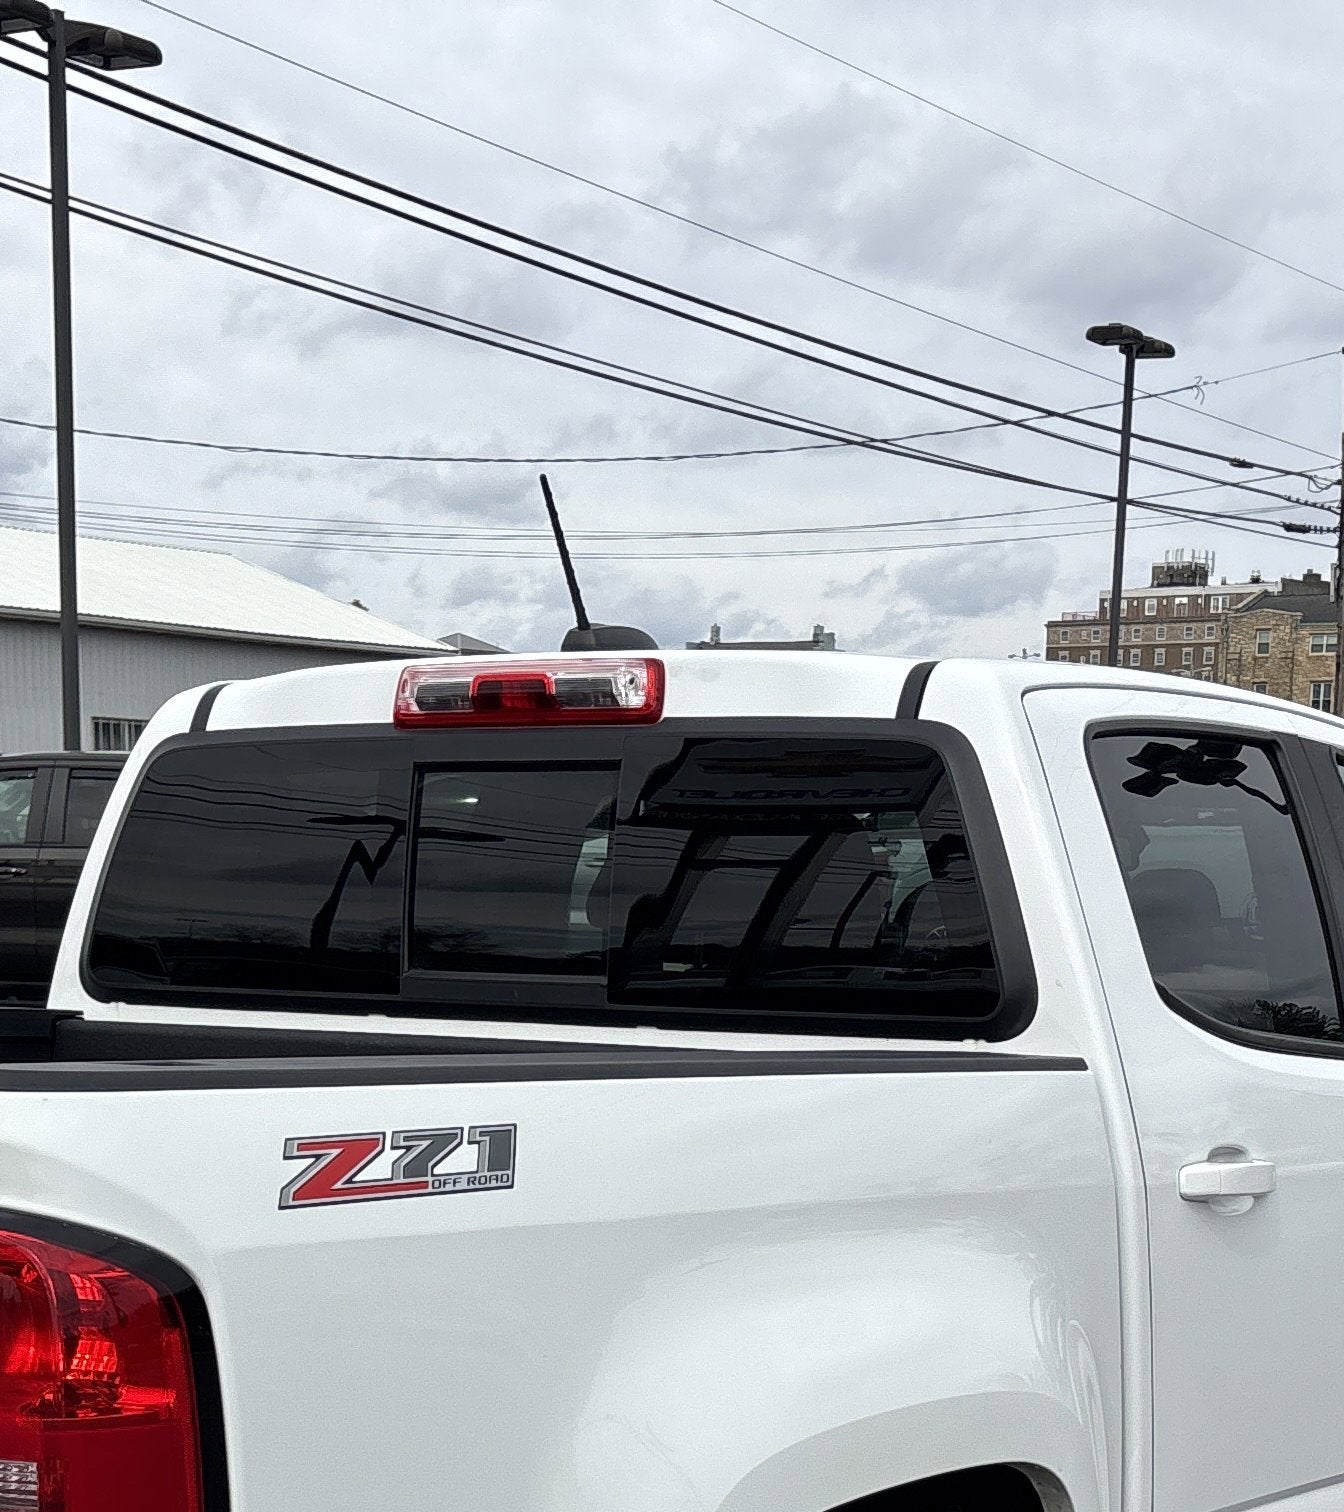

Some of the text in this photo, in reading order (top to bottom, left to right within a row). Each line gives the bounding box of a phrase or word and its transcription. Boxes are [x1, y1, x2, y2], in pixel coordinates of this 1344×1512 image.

[278, 1122, 518, 1211] Z71
[431, 1172, 511, 1190] OFF ROAD
